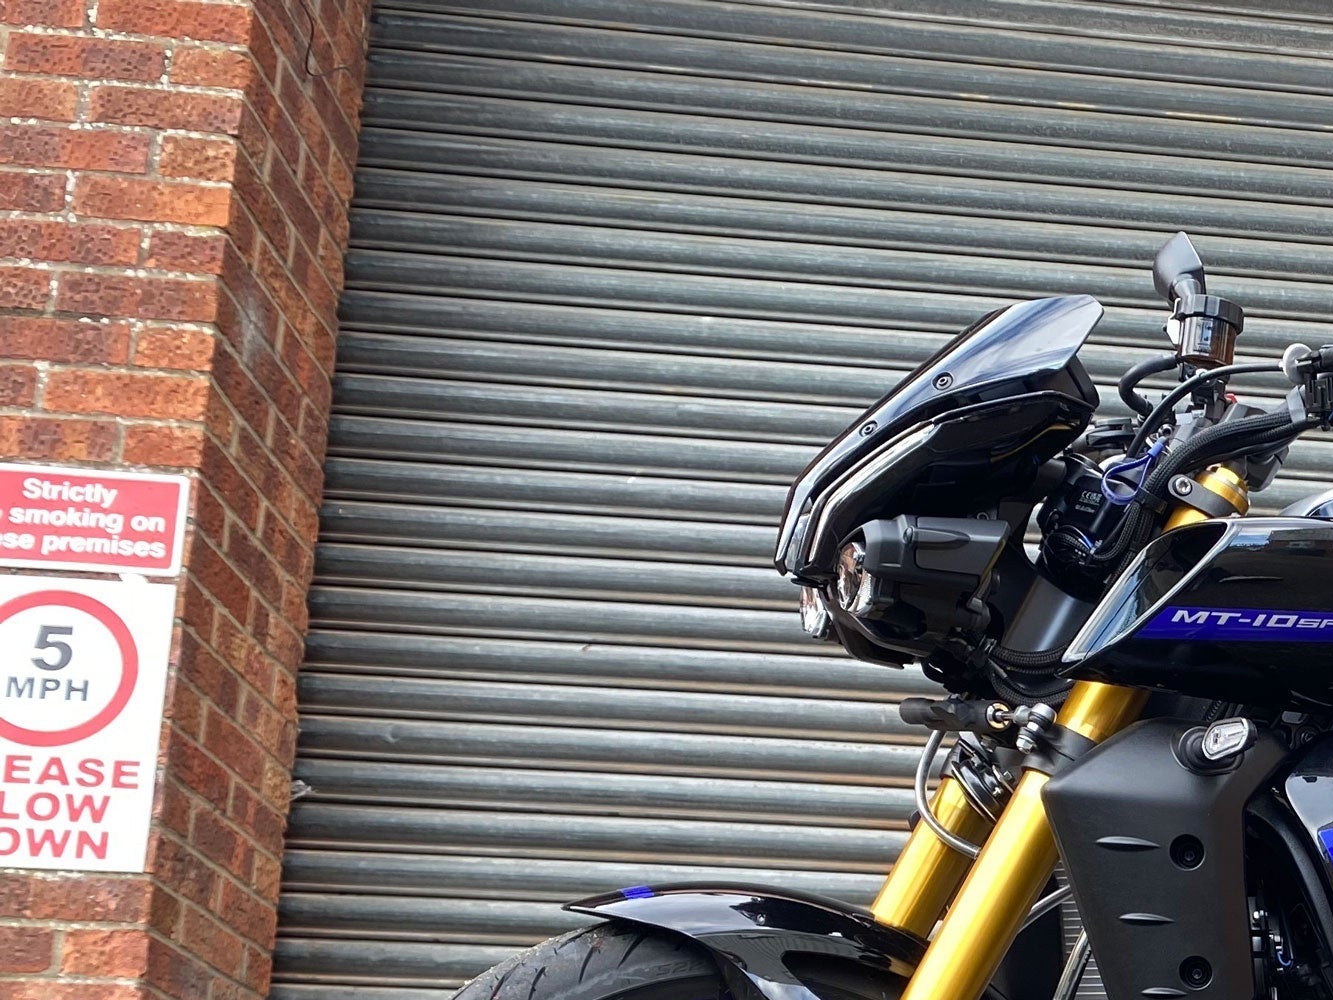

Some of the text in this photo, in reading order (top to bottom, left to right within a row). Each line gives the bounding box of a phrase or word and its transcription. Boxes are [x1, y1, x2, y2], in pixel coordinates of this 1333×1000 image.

[22, 477, 118, 508] Strictly
[8, 506, 124, 534] smoking
[130, 515, 166, 532] on
[0, 532, 166, 558] se premises
[30, 624, 73, 671] 5
[6, 675, 89, 701] MPH
